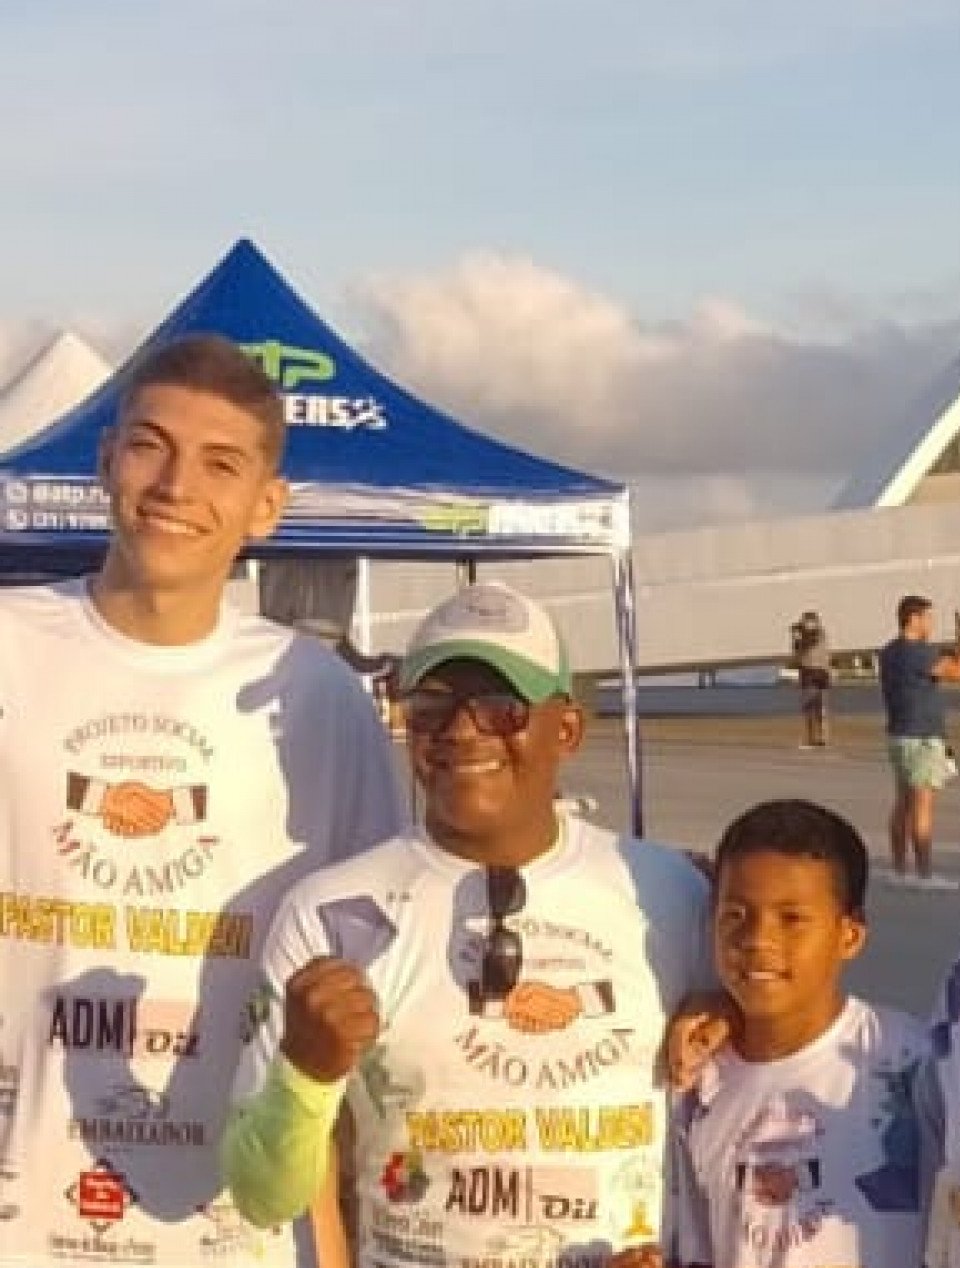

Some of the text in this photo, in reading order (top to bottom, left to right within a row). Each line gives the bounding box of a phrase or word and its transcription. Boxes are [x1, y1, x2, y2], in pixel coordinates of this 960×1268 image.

[123, 836, 220, 897] AMIGA
[0, 891, 116, 950] PASTOR
[50, 997, 126, 1051] ADM
[454, 1026, 635, 1089] MÃO AMIGA
[406, 1109, 527, 1152] PASTOR
[445, 1166, 598, 1220] ADM Oil
